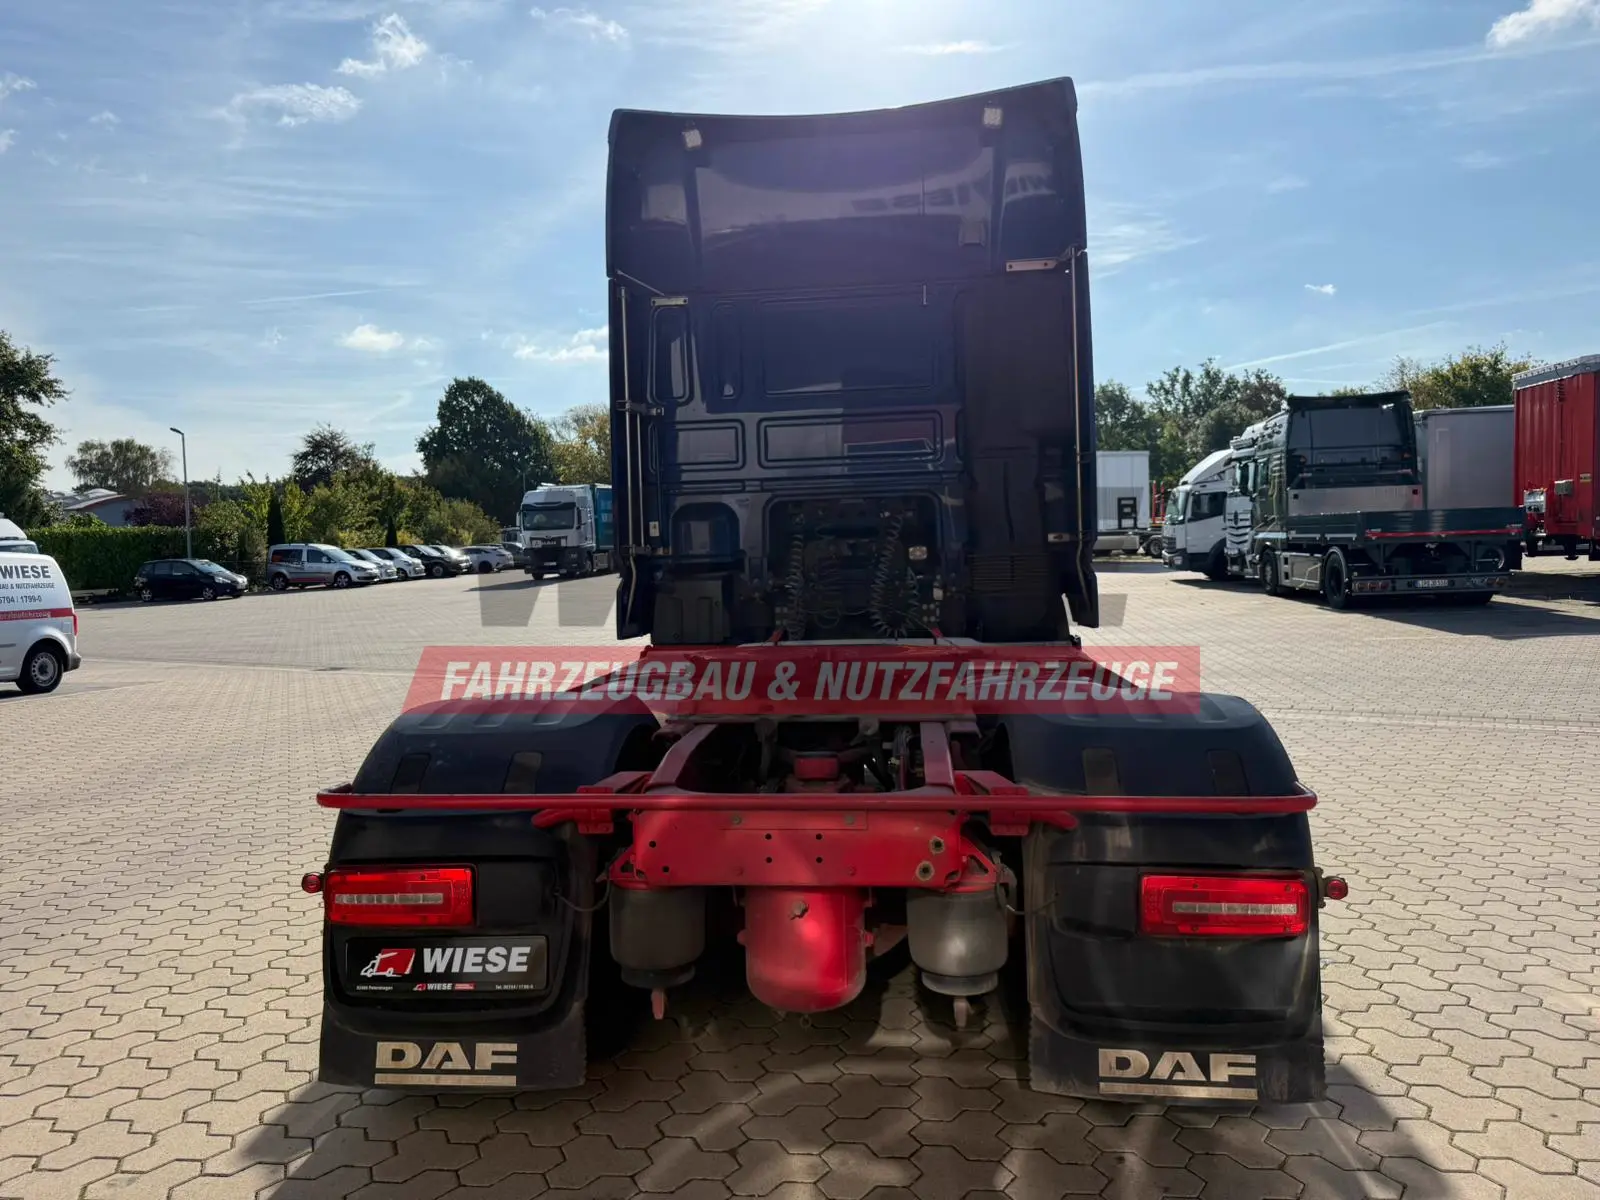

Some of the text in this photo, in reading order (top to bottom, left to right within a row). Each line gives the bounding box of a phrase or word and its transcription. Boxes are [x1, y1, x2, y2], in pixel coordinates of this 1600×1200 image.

[0, 565, 51, 579] WIESE
[423, 946, 531, 974] WIESE
[375, 1041, 518, 1071] DAF
[1098, 1048, 1256, 1082] DAF
